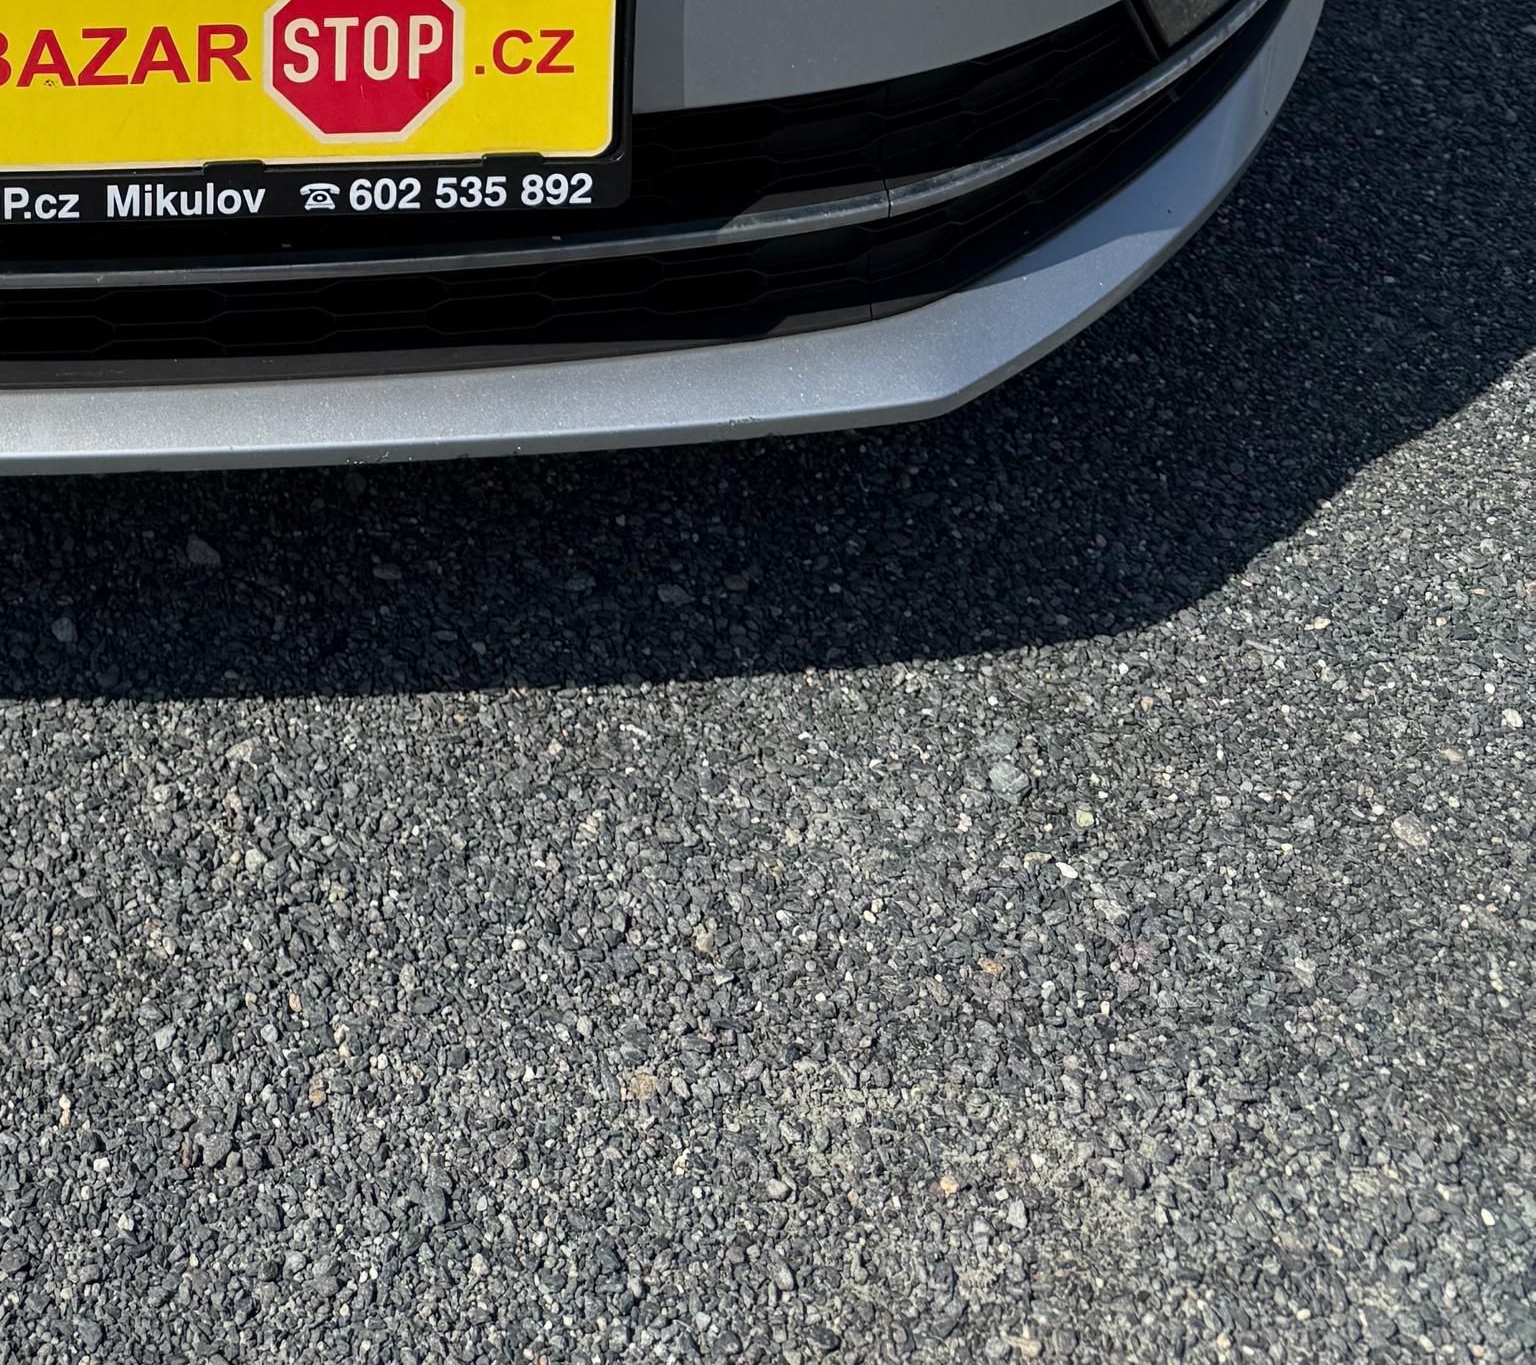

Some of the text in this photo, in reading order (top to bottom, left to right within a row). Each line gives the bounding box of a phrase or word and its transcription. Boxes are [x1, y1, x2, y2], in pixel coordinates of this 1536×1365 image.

[106, 182, 266, 218] Mikulov
[349, 177, 422, 212] 602
[435, 175, 507, 208] 535
[521, 173, 593, 206] 892
